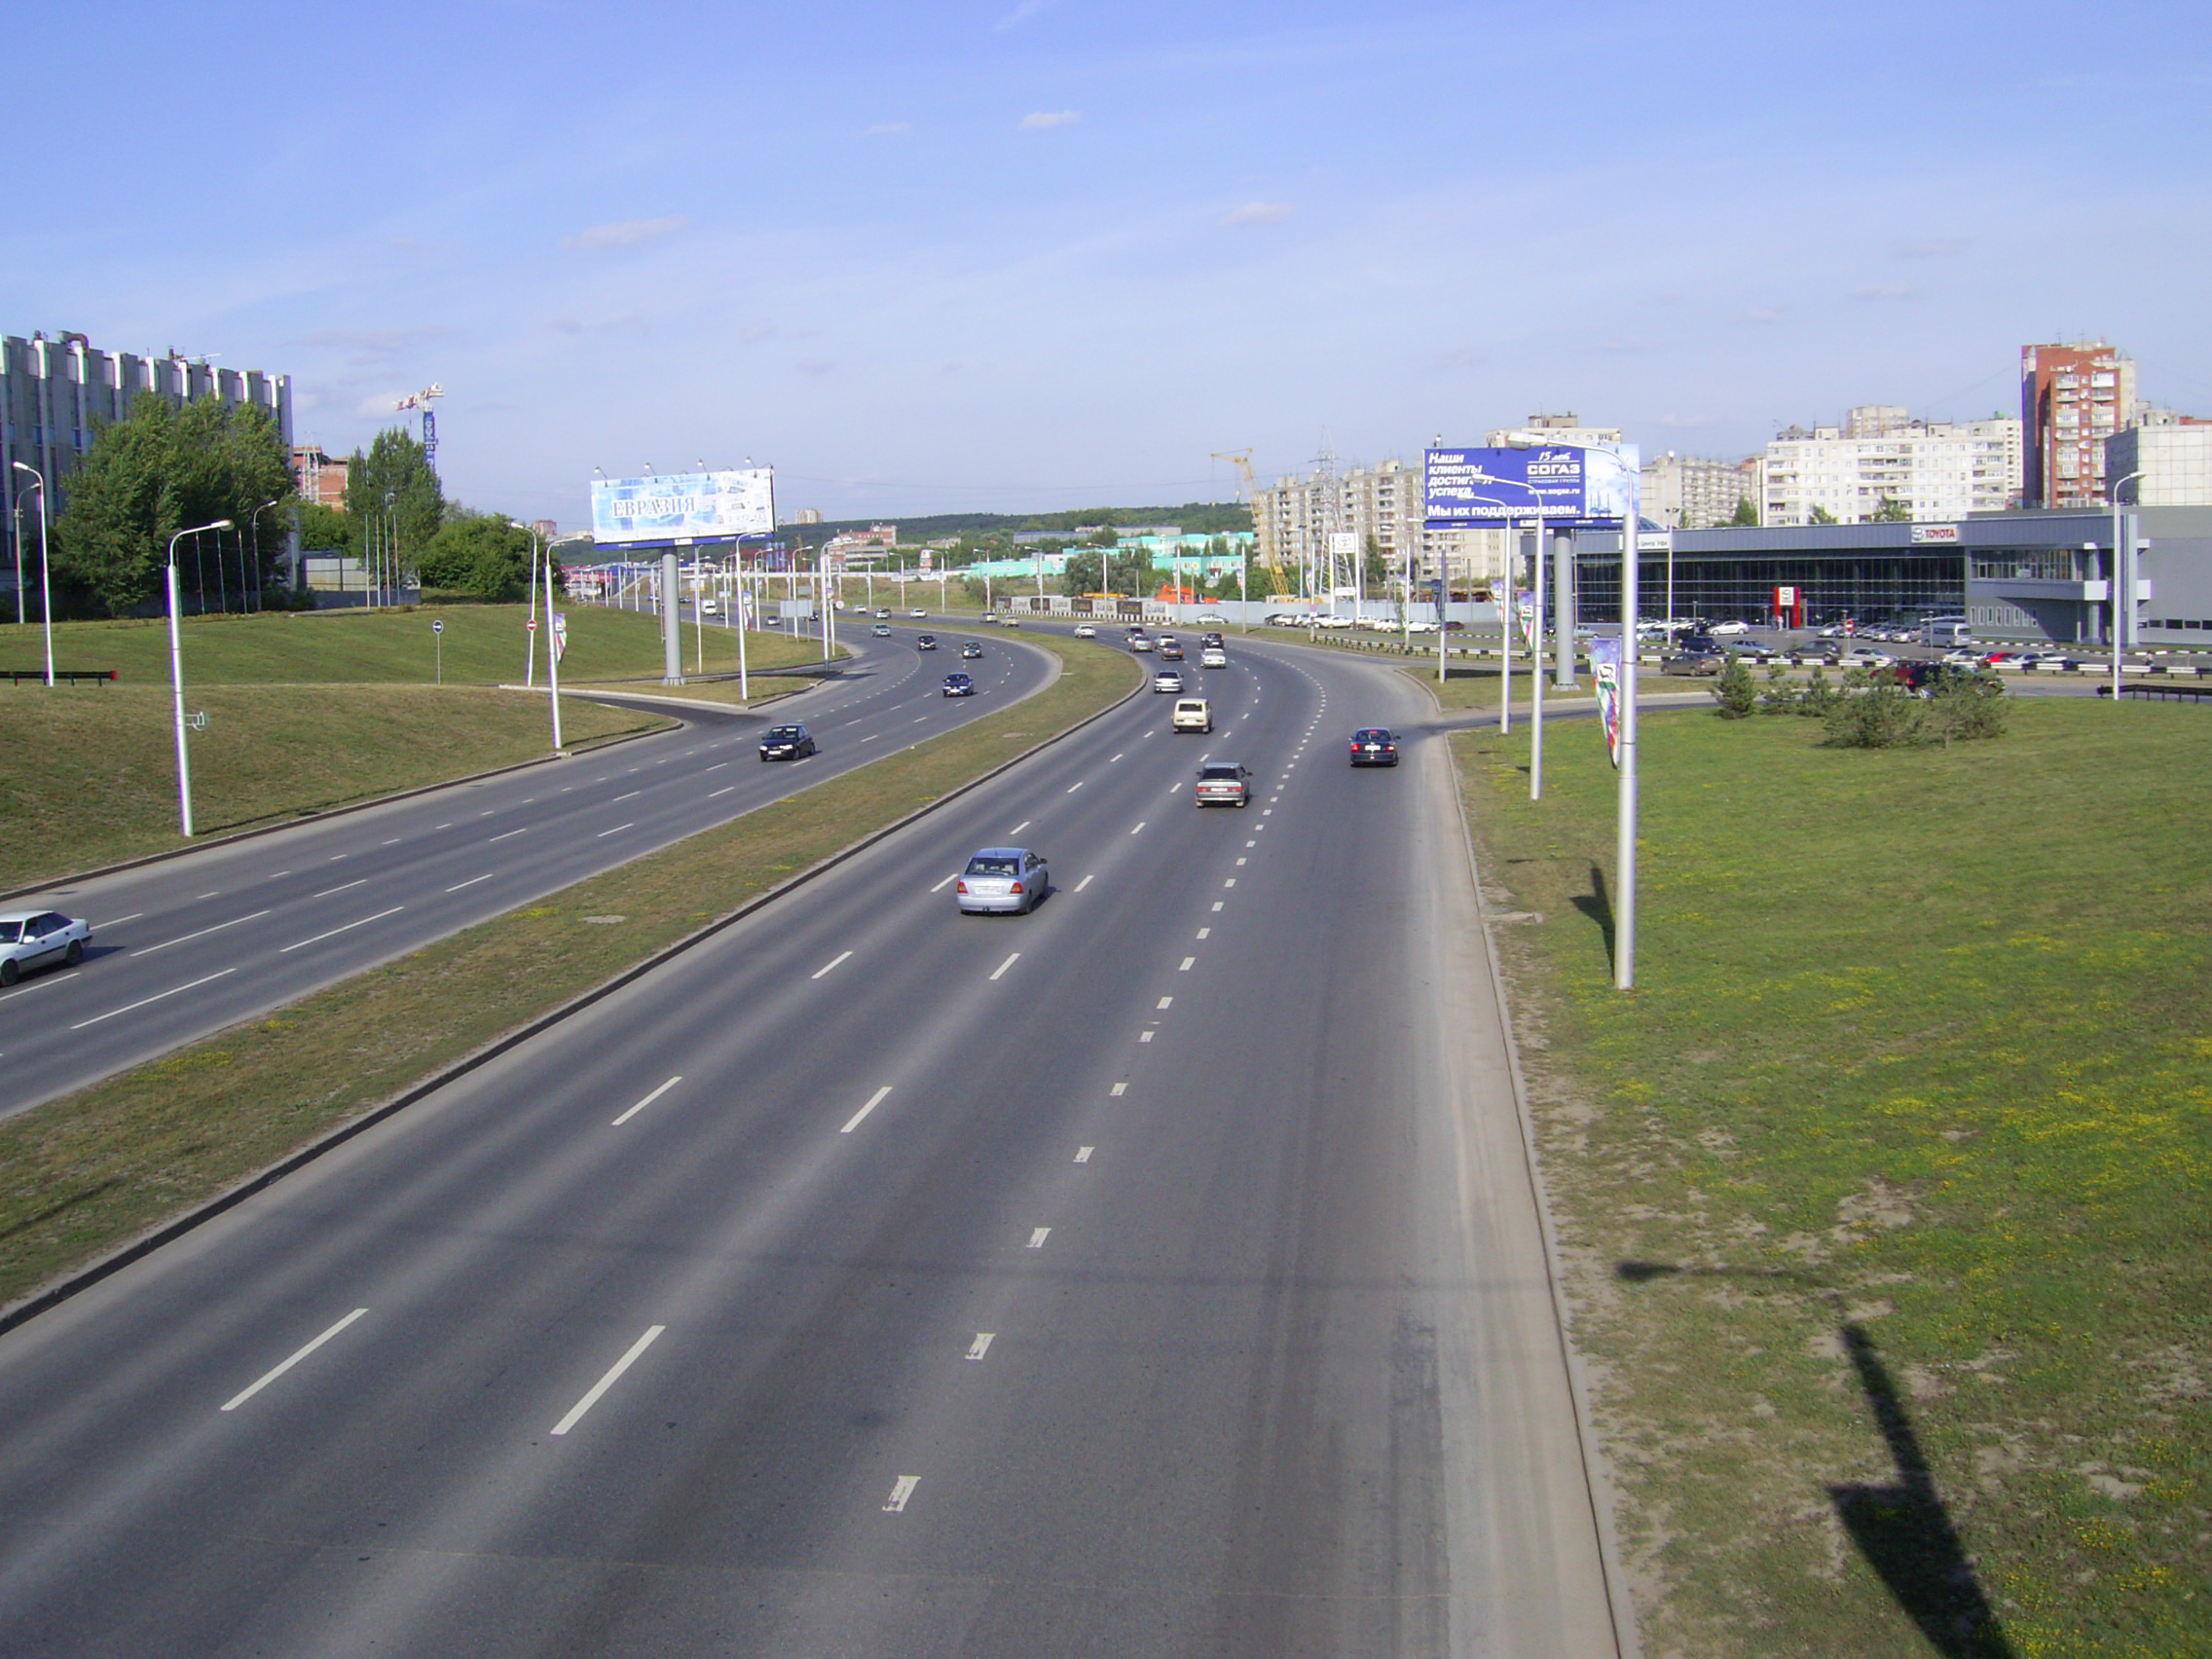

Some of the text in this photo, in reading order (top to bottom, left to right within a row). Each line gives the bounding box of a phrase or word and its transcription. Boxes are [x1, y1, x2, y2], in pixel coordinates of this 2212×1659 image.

[1428, 453, 1464, 463] Наши
[1428, 464, 1483, 475] клиенты
[1527, 464, 1580, 475] СОГАЗ
[612, 498, 695, 517] ЕВРАЗИЯ
[1427, 505, 1452, 516] Мы
[1453, 506, 1470, 516] их
[1925, 529, 1956, 538] TOYOTA
